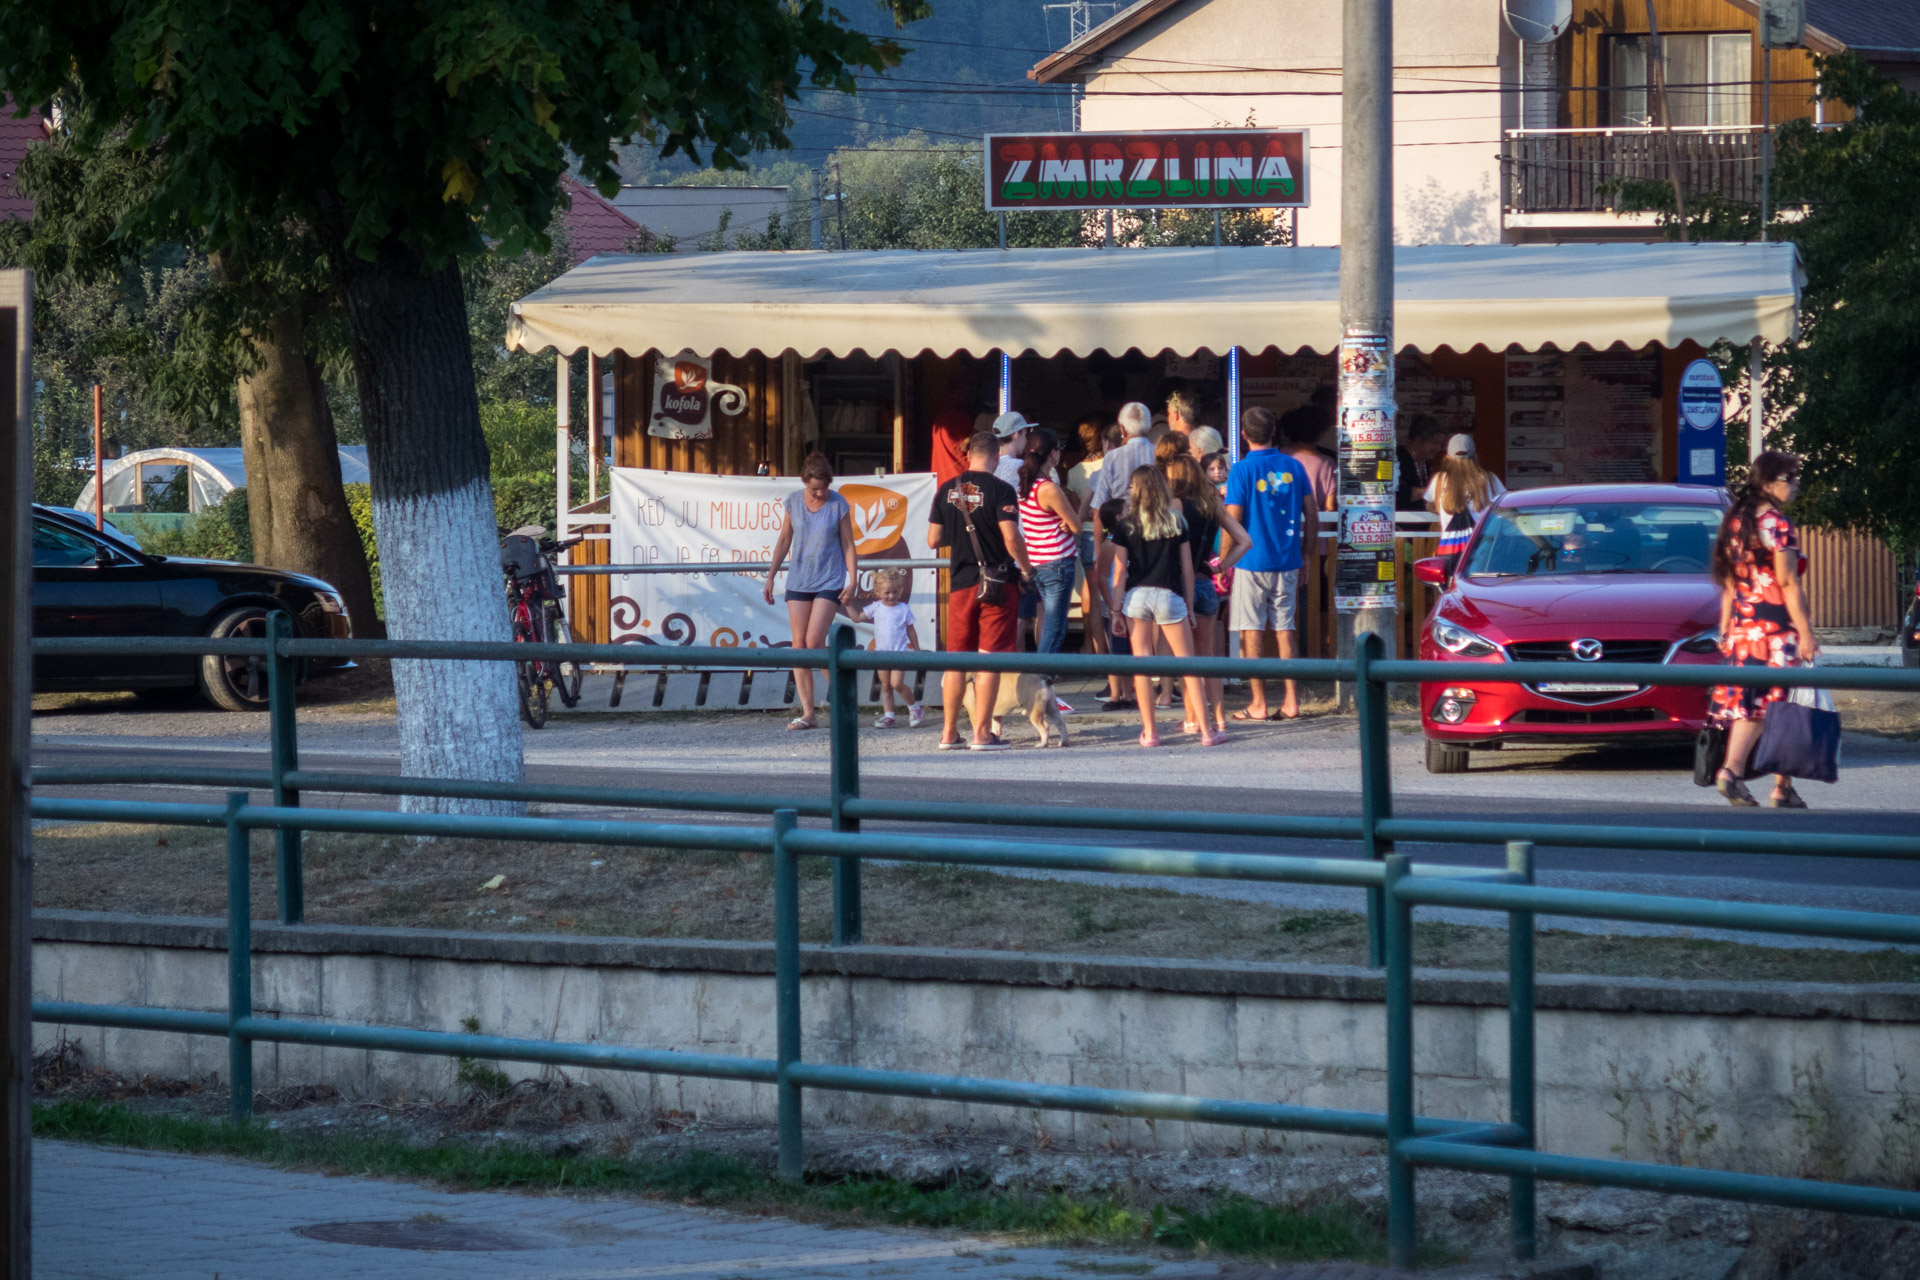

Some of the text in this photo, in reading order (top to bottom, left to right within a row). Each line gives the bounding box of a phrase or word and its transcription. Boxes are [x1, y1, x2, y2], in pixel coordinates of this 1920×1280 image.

[1000, 139, 1295, 200] ZMRZLINA
[664, 394, 701, 413] kofola
[1353, 433, 1392, 443] 15.9.2017
[674, 500, 699, 529] JU
[1353, 521, 1392, 533] KYSAK
[1353, 534, 1392, 544] 15.9.2017
